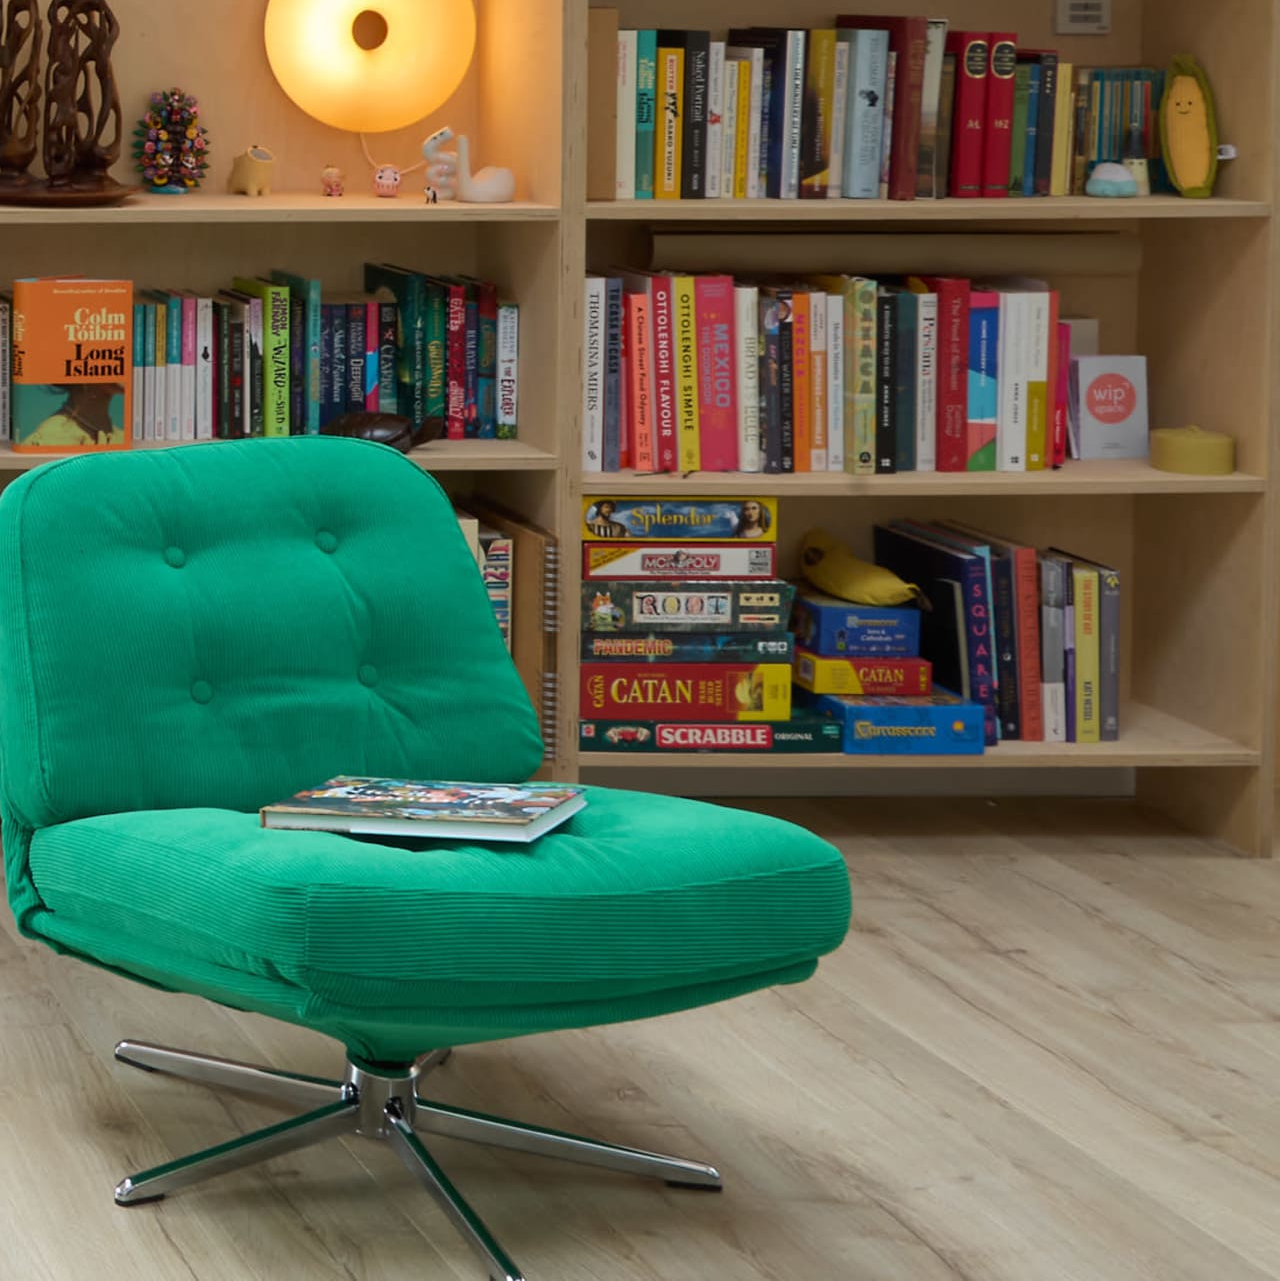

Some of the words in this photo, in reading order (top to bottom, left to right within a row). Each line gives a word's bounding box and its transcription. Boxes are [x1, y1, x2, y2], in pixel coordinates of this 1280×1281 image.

[696, 51, 704, 82] Naked
[694, 85, 703, 121] Portrait
[609, 289, 620, 302] TU
[74, 307, 126, 325] Colm
[608, 305, 619, 329] CASA
[64, 324, 126, 342] Tóibín
[587, 293, 600, 369] THOMASINA
[608, 333, 619, 343] MI
[657, 291, 669, 373] OTTOLENGHI
[681, 294, 692, 378] OTTOLENGHI
[75, 344, 125, 362] Long
[922, 317, 935, 376] Persiana
[64, 358, 124, 377] Island
[608, 346, 619, 373] CASA
[714, 324, 730, 407] MEXICO
[588, 373, 600, 411] MIERS
[659, 380, 671, 436] FLAVOUR
[683, 386, 694, 430] SIMPLE
[632, 504, 716, 531] Splendor
[644, 556, 720, 569] MONOPOLY
[636, 594, 729, 615] ROOT
[594, 639, 671, 655] PANDEMIC
[859, 668, 903, 683] CATAN
[593, 675, 605, 708] CATAN
[610, 679, 692, 703] CATAN
[660, 728, 767, 745] SCRABBLE
[775, 733, 813, 741] ORIGINAL
